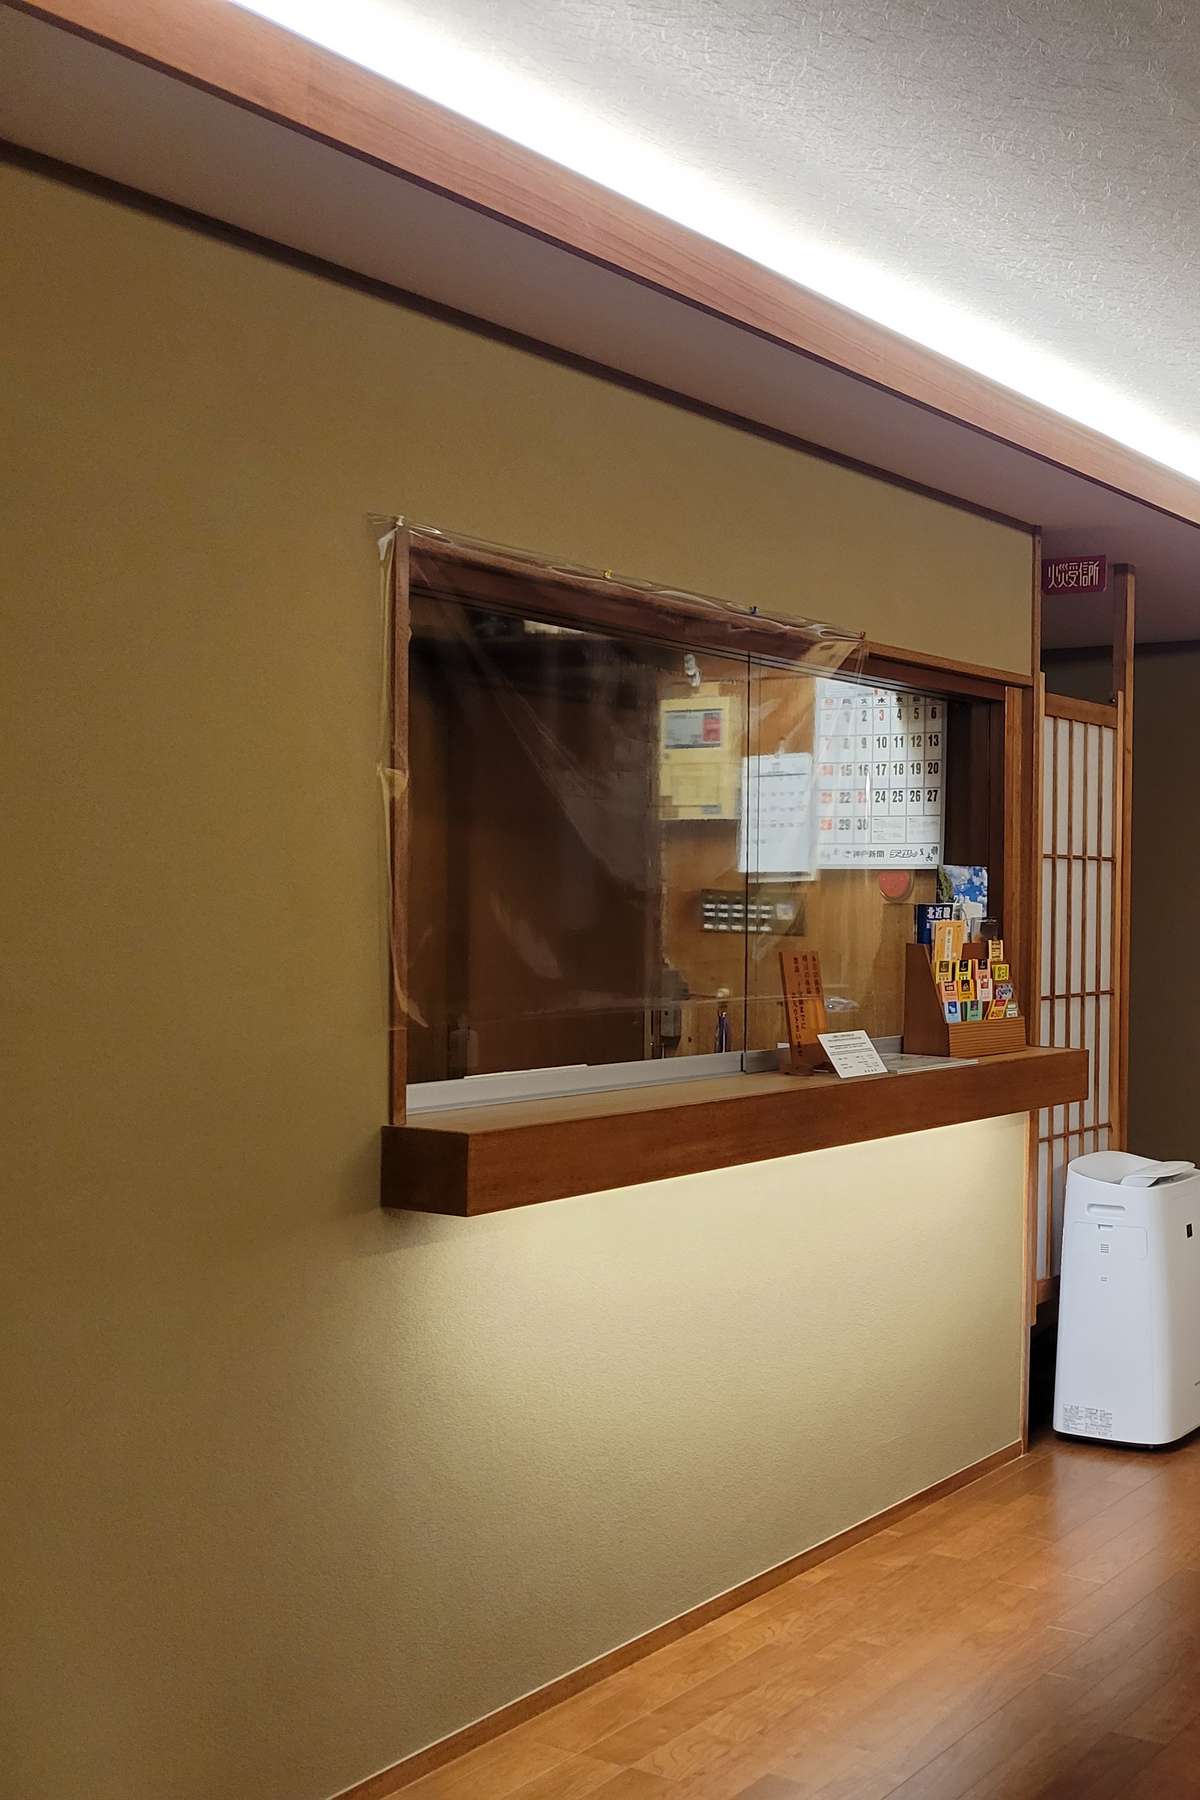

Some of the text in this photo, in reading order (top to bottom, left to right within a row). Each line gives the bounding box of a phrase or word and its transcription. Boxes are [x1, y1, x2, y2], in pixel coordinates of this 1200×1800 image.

[1047, 560, 1100, 589] 火災受信所
[861, 710, 868, 722] 2
[878, 709, 885, 721] 3
[896, 708, 902, 721] 4
[913, 707, 920, 720] 5
[930, 706, 937, 719] 6
[861, 737, 868, 749] 9
[876, 736, 888, 748] 10
[893, 736, 904, 748] 11
[911, 735, 922, 747] 12
[928, 734, 939, 747] 13
[841, 764, 852, 776] 15
[858, 764, 869, 776] 16
[876, 763, 887, 775] 17
[893, 763, 904, 775] 18
[910, 762, 921, 775] 19
[927, 762, 939, 774] 20
[839, 791, 851, 804] 22
[874, 790, 886, 803] 24
[892, 790, 904, 803] 25
[909, 790, 921, 802] 26
[927, 789, 938, 802] 27
[838, 818, 851, 831] 29
[857, 818, 868, 831] 30
